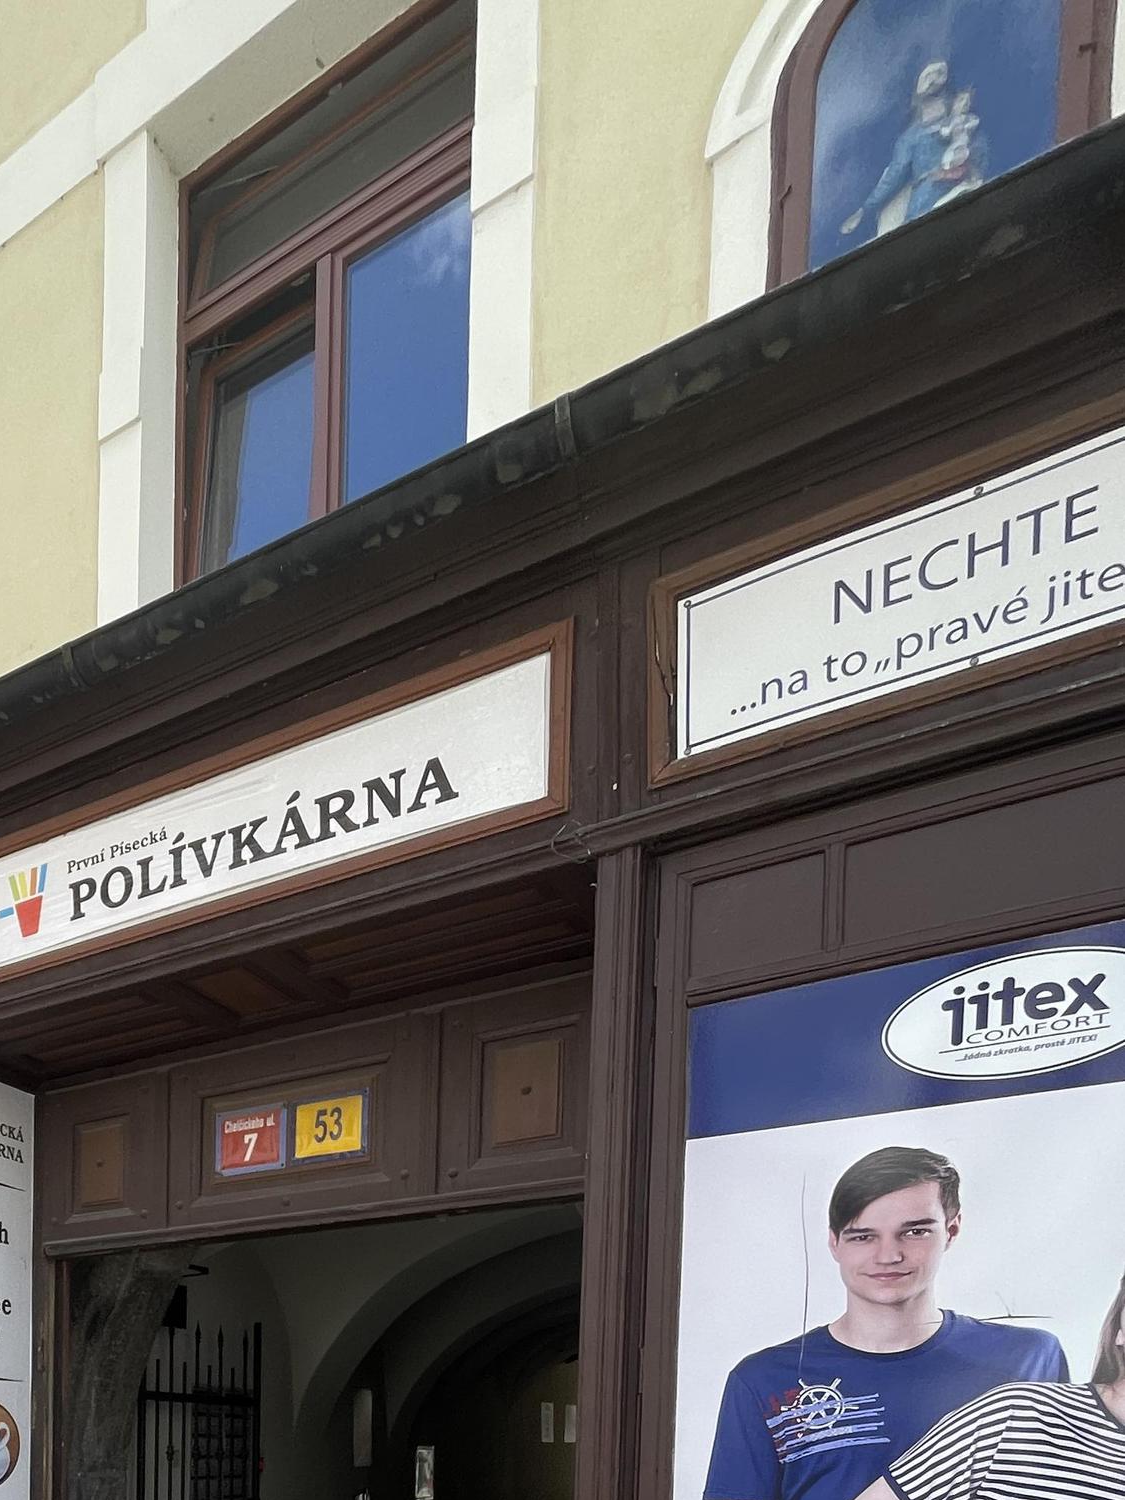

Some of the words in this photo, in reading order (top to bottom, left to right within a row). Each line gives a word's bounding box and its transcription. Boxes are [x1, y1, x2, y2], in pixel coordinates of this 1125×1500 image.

[834, 485, 1099, 625] NECHTE
[823, 651, 867, 682] to
[1040, 563, 1125, 625] jite
[67, 848, 105, 874] První
[110, 826, 168, 859] Písecká
[69, 756, 459, 921] POLÍVKÁRNA
[942, 973, 1110, 1046] jitex
[966, 1012, 1110, 1044] COMFORT
[1034, 1039, 1066, 1052] prostě
[244, 1133, 258, 1162] 7
[314, 1107, 343, 1143] 53
